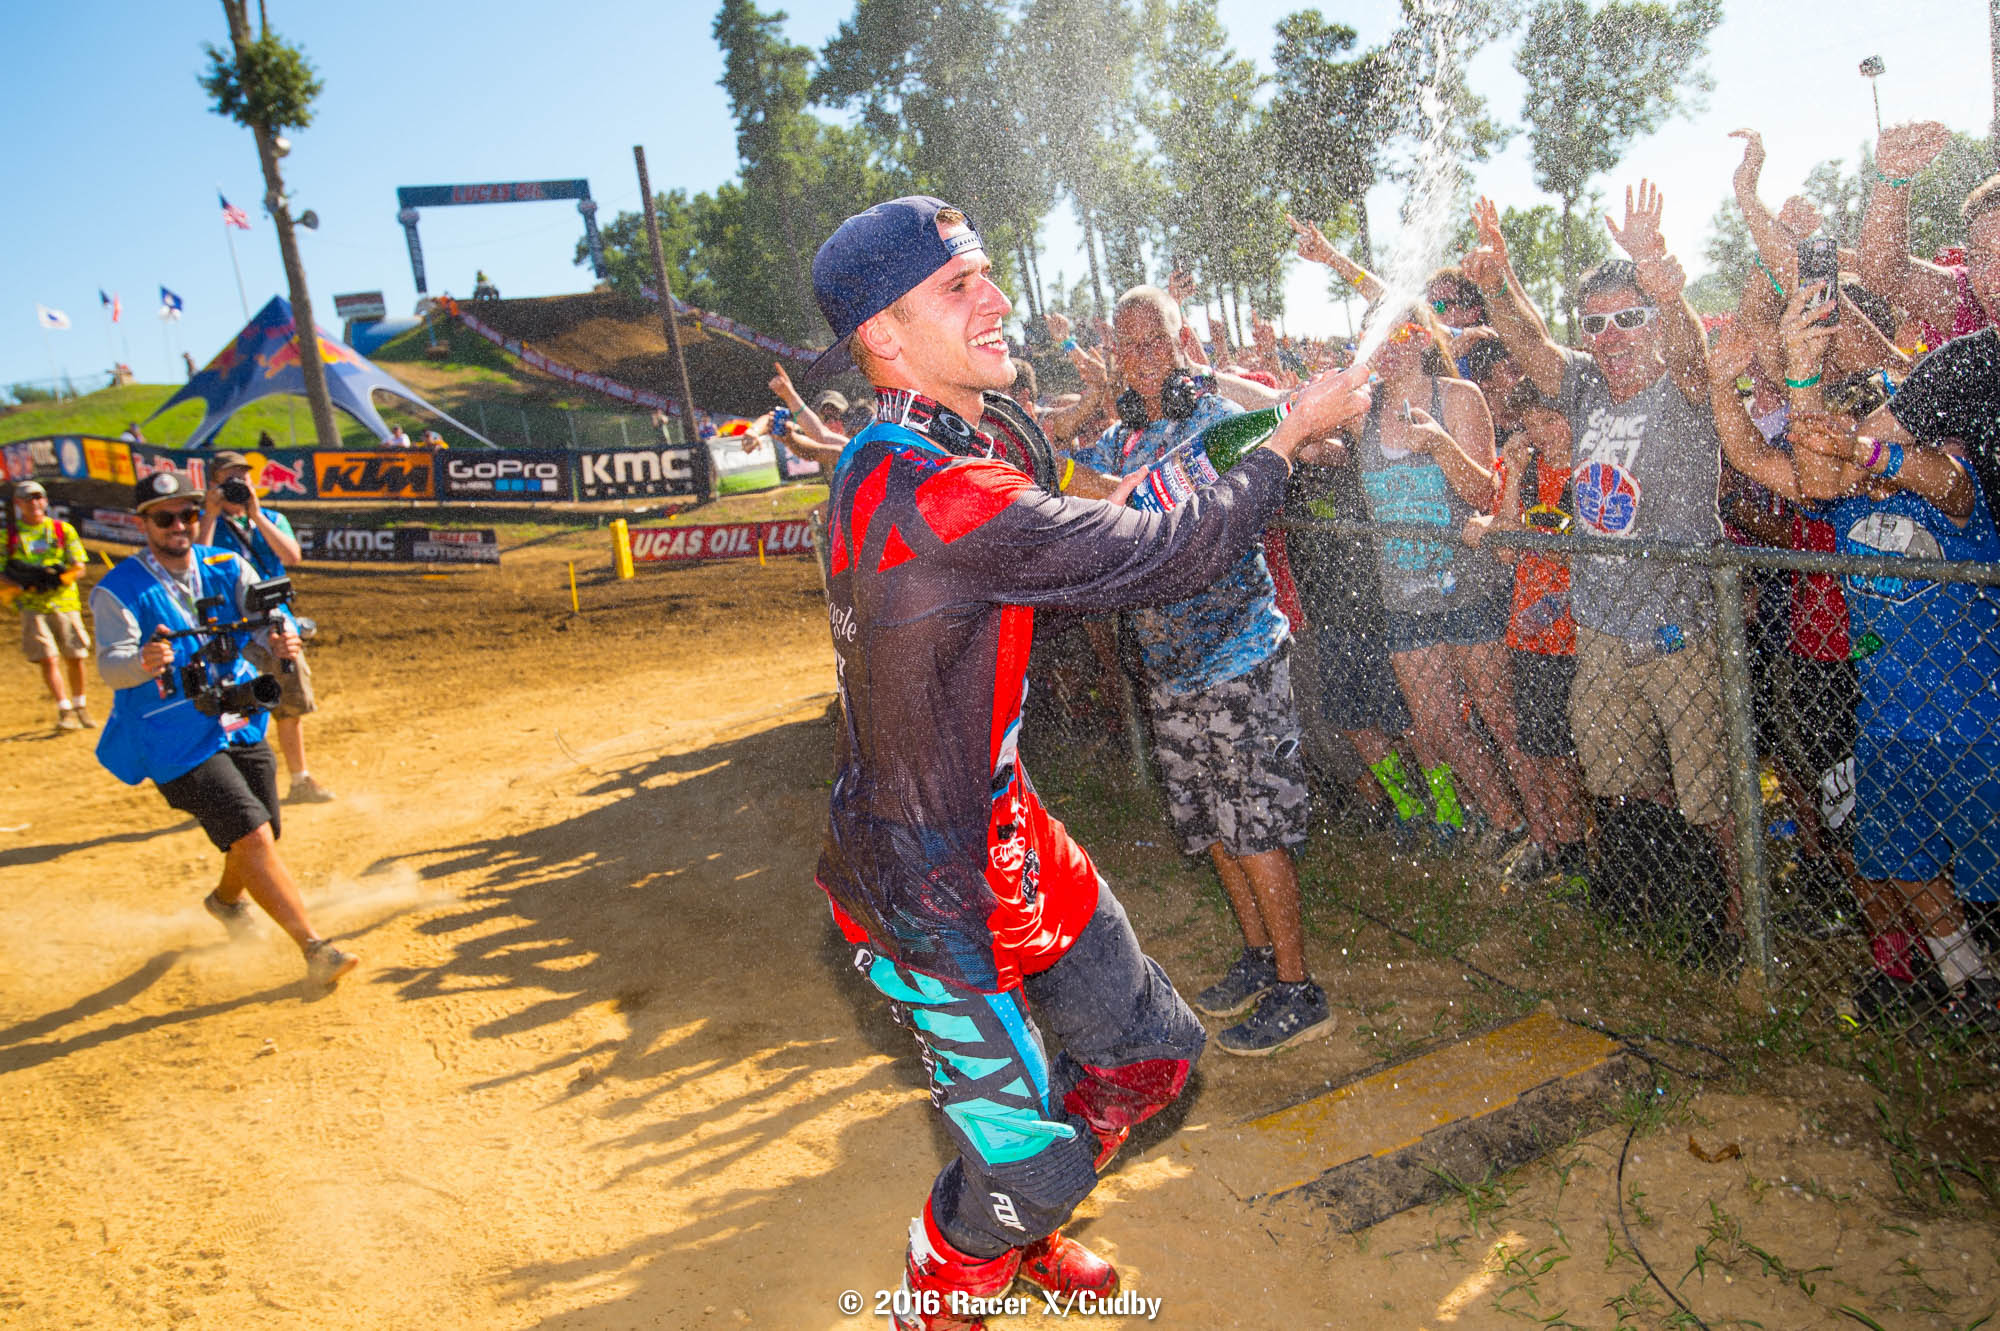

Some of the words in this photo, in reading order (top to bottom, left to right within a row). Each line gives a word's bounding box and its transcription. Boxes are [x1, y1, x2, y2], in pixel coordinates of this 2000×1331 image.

[453, 184, 511, 202] LUCAS
[514, 182, 545, 199] OIL
[321, 457, 430, 492] KTM
[448, 459, 558, 478] GoPro
[581, 450, 692, 485] KMC
[1171, 465, 1187, 485] LUCAS
[326, 530, 395, 550] KMC
[632, 529, 704, 558] UCAS
[710, 528, 752, 552] OIL
[766, 523, 814, 550] LUC
